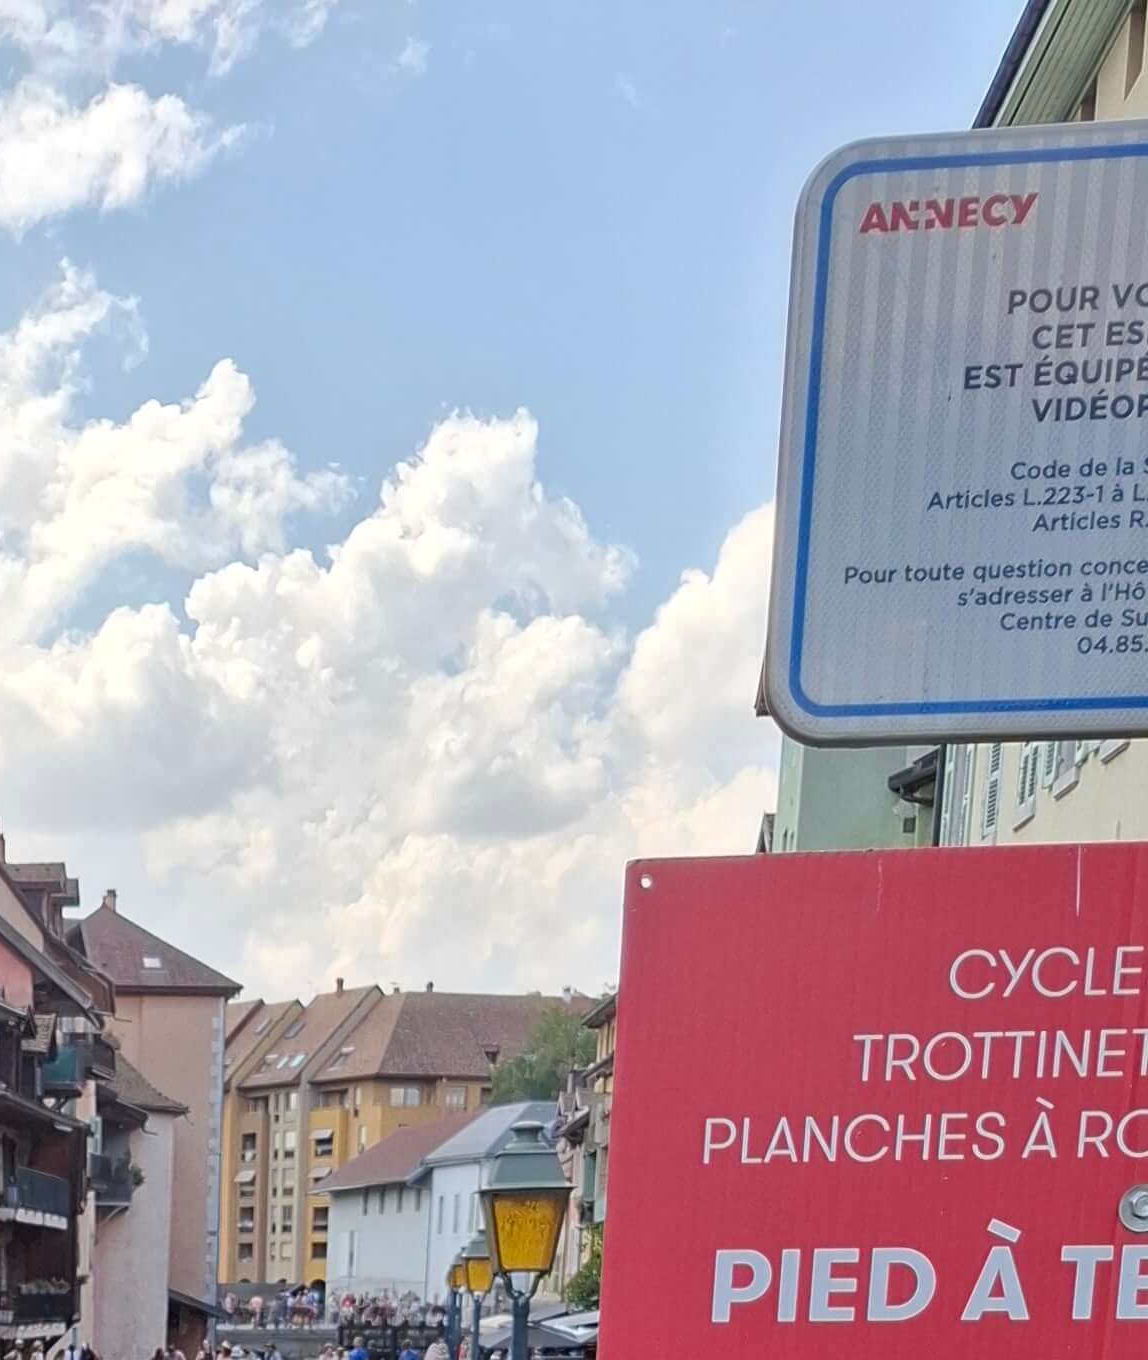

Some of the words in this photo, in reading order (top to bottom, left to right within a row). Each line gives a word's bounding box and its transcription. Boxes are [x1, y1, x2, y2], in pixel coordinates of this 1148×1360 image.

[859, 193, 1039, 233] ANNECY
[1007, 286, 1100, 315] POUR
[1032, 323, 1096, 350] CET
[1106, 321, 1148, 347] ES
[964, 363, 1023, 390] EST
[1011, 460, 1071, 480] Code
[1079, 458, 1108, 477] de
[1116, 457, 1134, 476] la
[927, 489, 1015, 511] Articles
[1023, 484, 1104, 506] L.223-1
[1112, 483, 1124, 502] à
[1032, 510, 1121, 532] Articles
[844, 565, 897, 584] Pour
[905, 563, 965, 582] toute
[973, 559, 1072, 583] question
[1080, 559, 1148, 576] conce
[957, 586, 1074, 607] s'adresser
[1081, 583, 1093, 602] à
[1000, 612, 1077, 632] Centre
[1085, 609, 1113, 628] de
[1121, 609, 1148, 627] Su
[949, 945, 1145, 1000] CYCLE
[702, 1110, 1006, 1166] PLANCHES
[1021, 1096, 1058, 1160] À
[710, 1247, 937, 1325] PIED
[960, 1217, 1031, 1322] À
